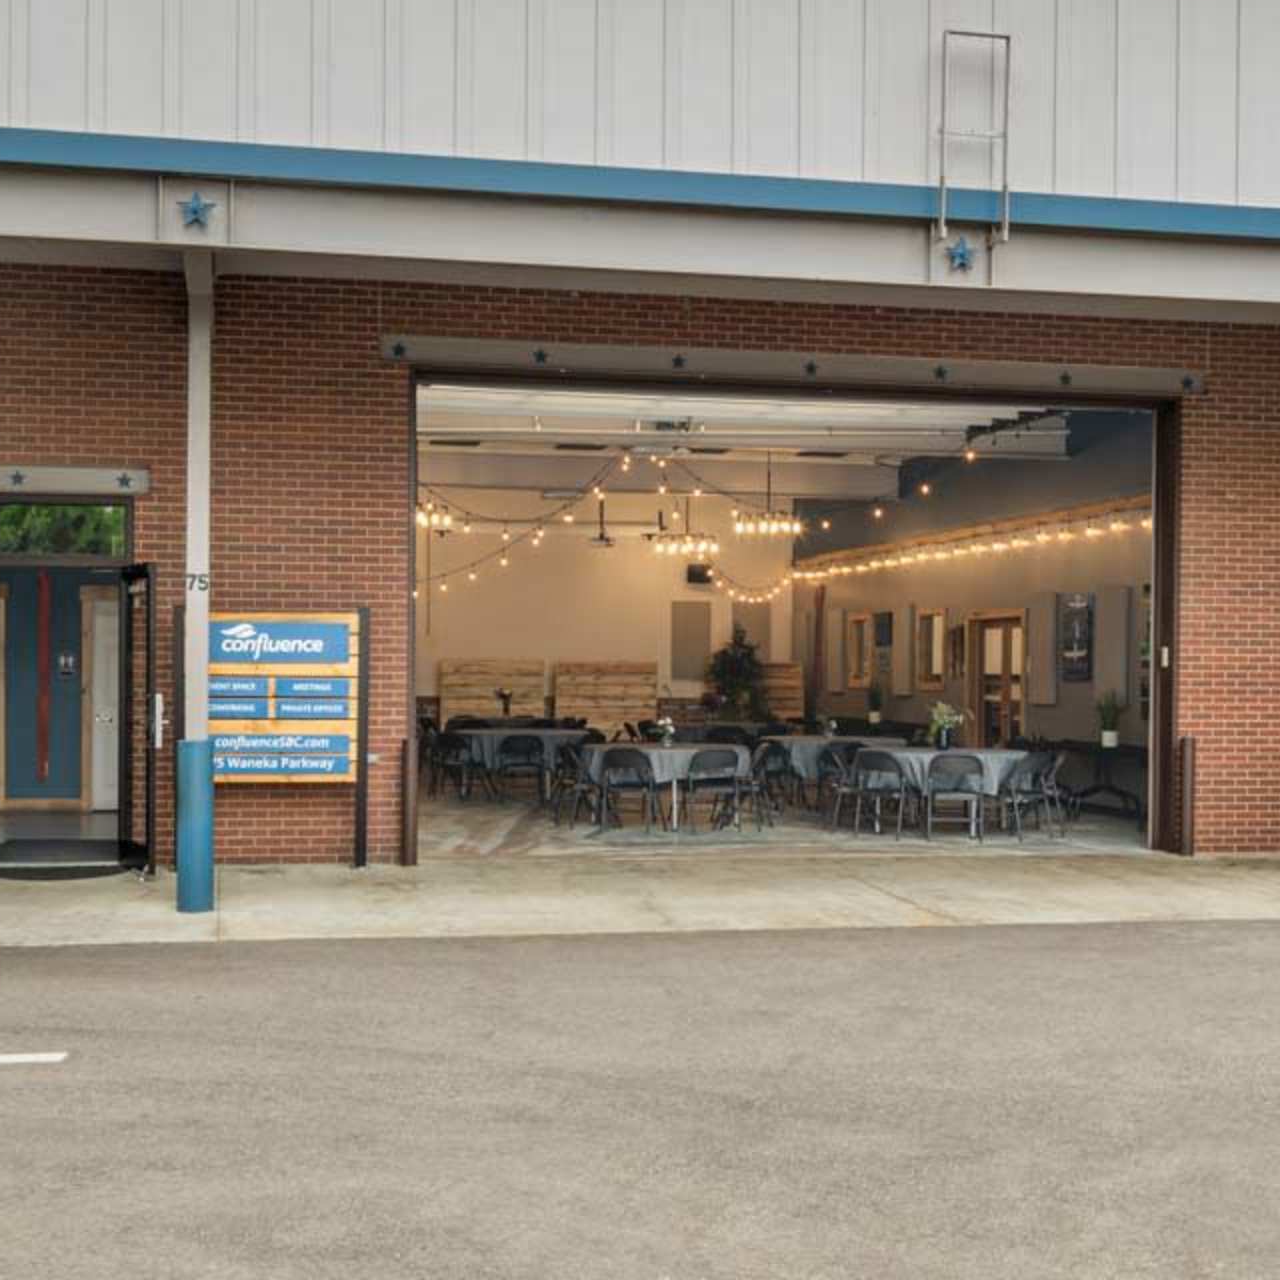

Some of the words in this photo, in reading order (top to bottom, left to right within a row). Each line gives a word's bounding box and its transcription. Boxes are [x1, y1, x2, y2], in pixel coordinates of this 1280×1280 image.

[187, 574, 209, 591] 75
[221, 633, 324, 660] confluence
[227, 756, 278, 769] Waneka
[281, 756, 335, 771] Parkway
